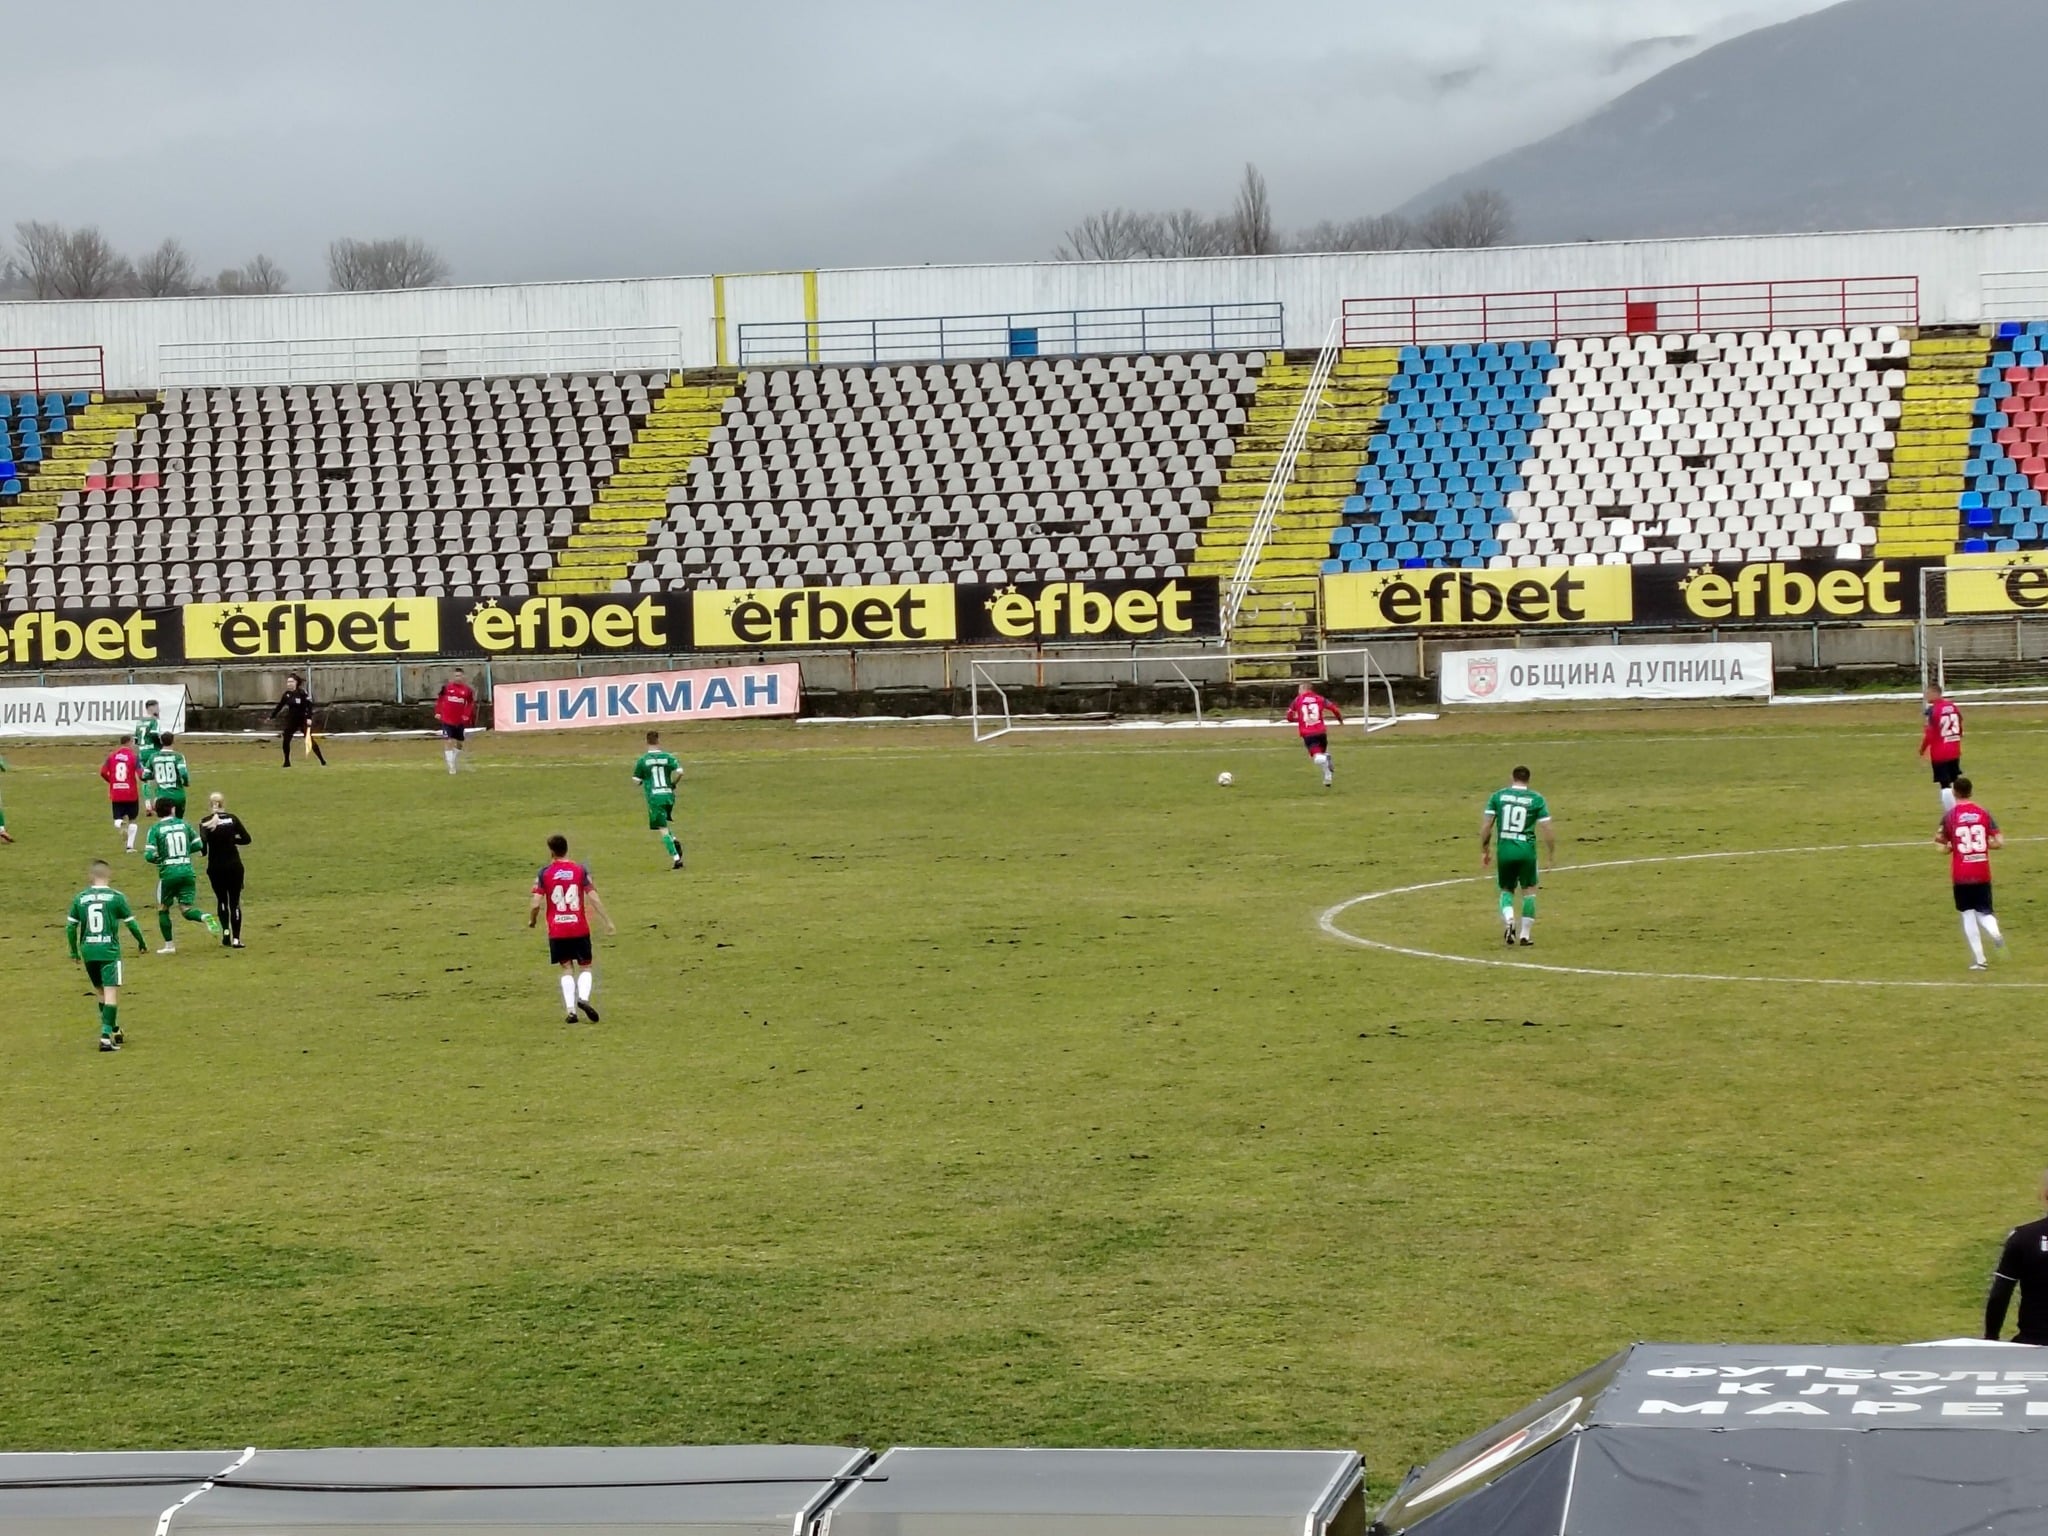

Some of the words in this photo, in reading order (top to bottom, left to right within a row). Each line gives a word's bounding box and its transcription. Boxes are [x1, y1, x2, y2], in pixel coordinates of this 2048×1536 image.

[1379, 568, 1585, 624] efbet
[1686, 561, 1901, 618] efbet
[731, 588, 926, 642] efbet
[991, 579, 1192, 636] efbet
[0, 609, 158, 663] fbet
[220, 601, 409, 656] efbet
[473, 595, 667, 650] efbet
[1510, 661, 1616, 689] ОБЩИНА
[1626, 658, 1744, 687] ДУПНИЦА
[514, 672, 780, 724] НИКМАН
[0, 702, 46, 728] ИНА
[55, 700, 145, 726] ДУПНИЦ
[1301, 703, 1320, 724] 13
[1940, 714, 1960, 736] 23
[115, 762, 127, 782] 8
[650, 766, 667, 788] 11
[1502, 804, 1527, 832] 19
[166, 832, 187, 857] 10
[1955, 824, 1987, 853] 33
[551, 884, 580, 911] 44
[88, 903, 104, 933] 6
[1717, 1381, 2029, 1396] КЛУБ
